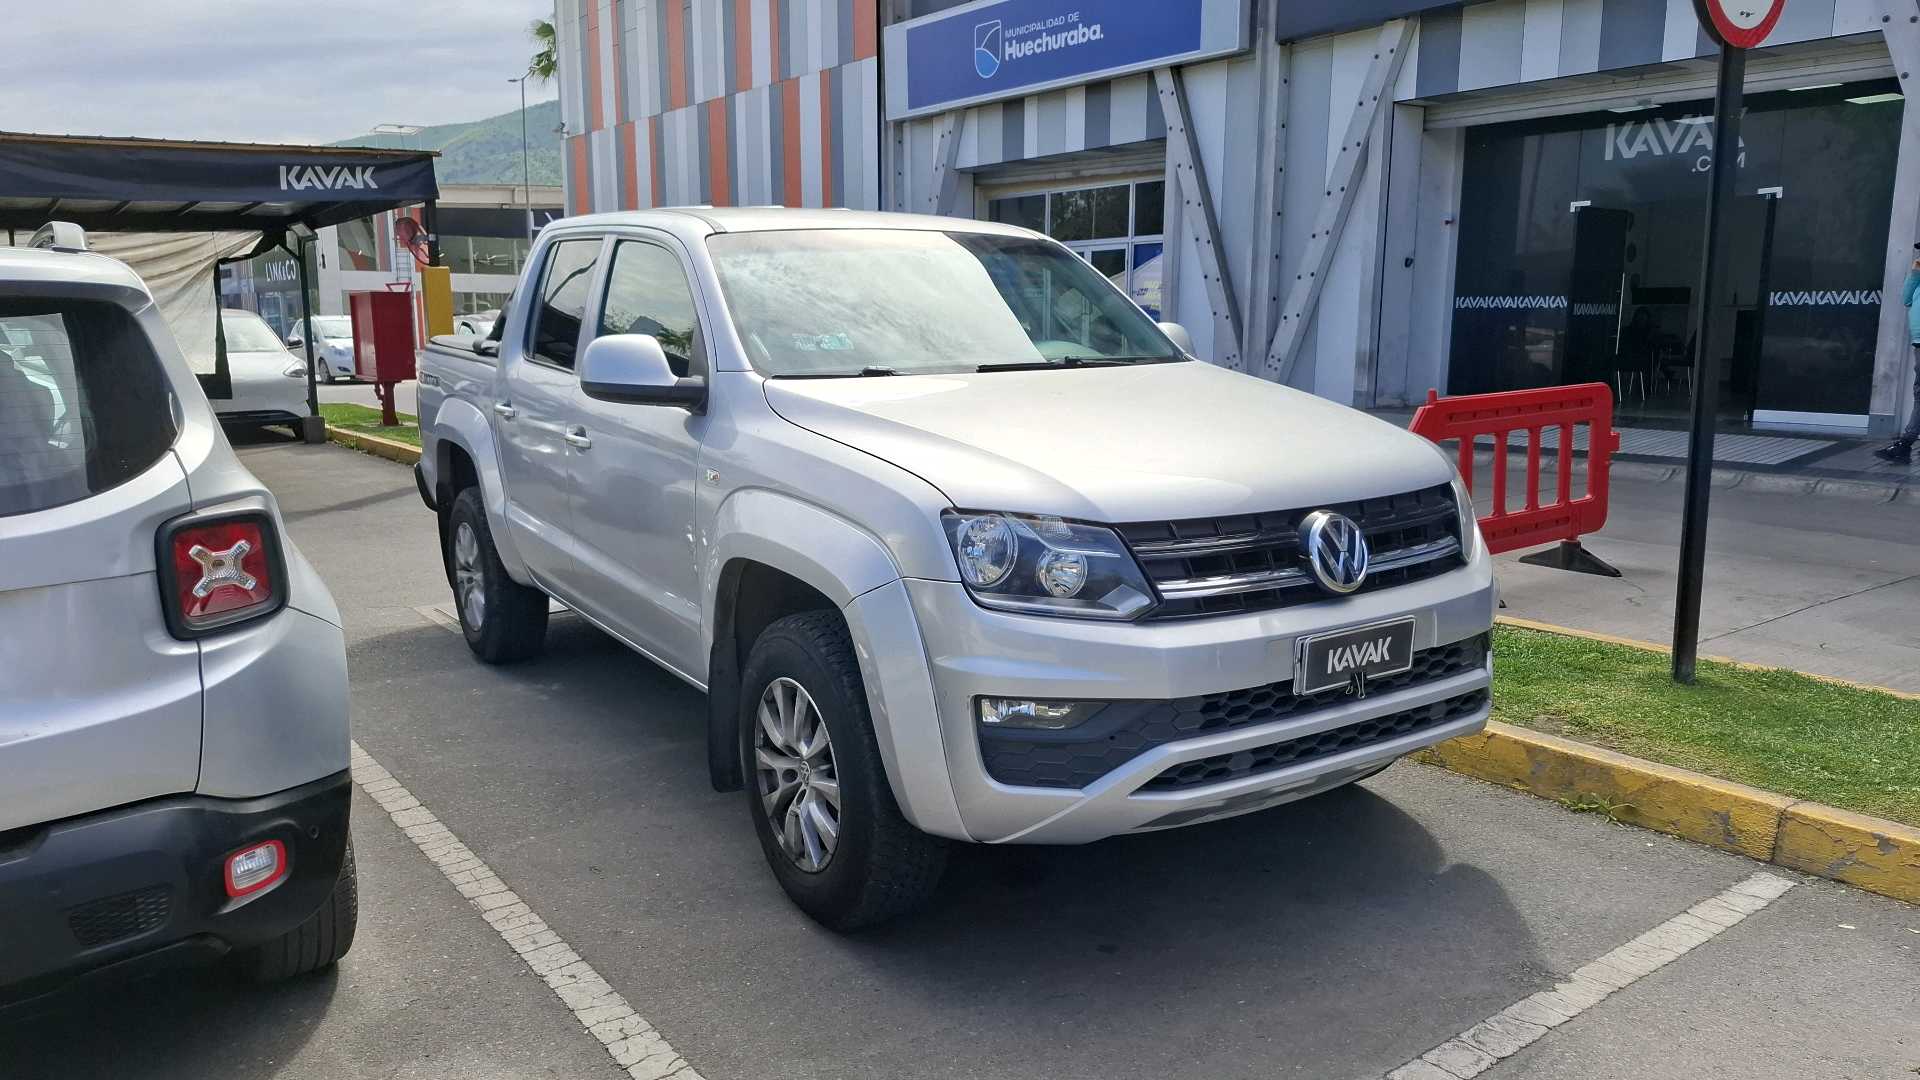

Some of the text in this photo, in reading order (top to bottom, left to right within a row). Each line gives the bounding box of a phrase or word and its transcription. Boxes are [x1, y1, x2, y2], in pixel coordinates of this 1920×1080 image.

[1005, 11, 1080, 39] MUNICIPALIDAD DE
[1005, 23, 1104, 61] Huechuraba.
[1605, 110, 1748, 160] KAVA
[280, 165, 378, 190] KAVAK
[1691, 151, 1746, 172] .CM
[1327, 636, 1392, 674] KAVAK
